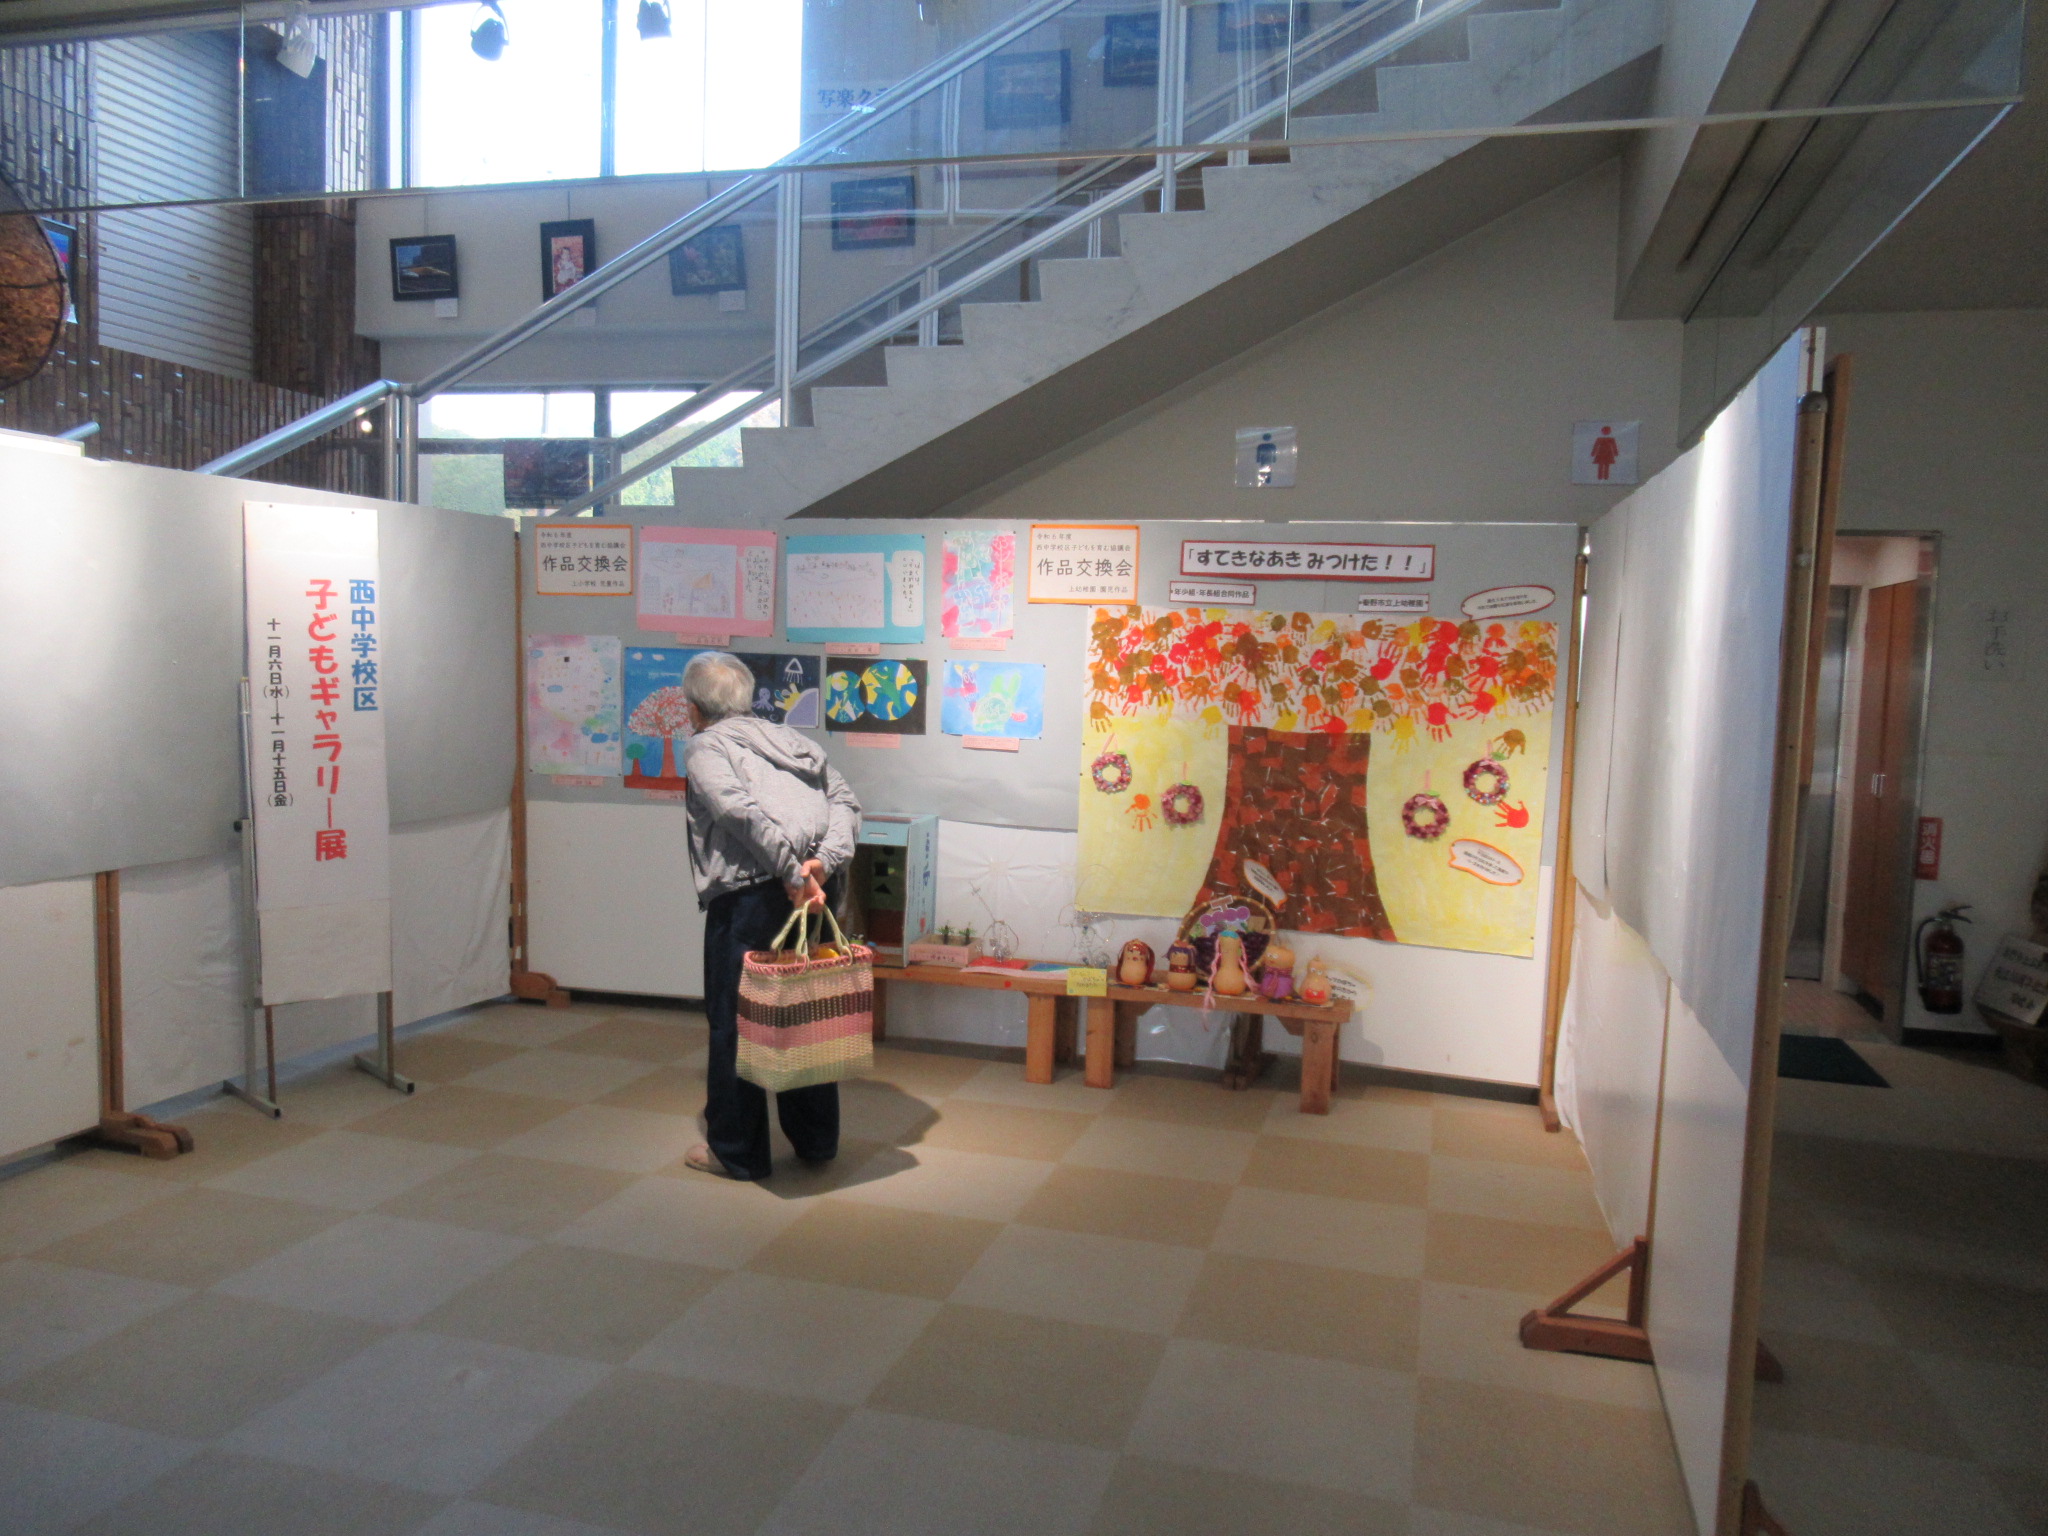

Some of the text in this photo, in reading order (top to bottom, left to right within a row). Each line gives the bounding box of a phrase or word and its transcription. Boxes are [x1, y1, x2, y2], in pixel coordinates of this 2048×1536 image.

[543, 554, 628, 572] 作品交換会
[1037, 558, 1133, 577] 作品交換会
[349, 579, 378, 711] 西中学校区
[305, 579, 347, 861] 子どもギャラリー展
